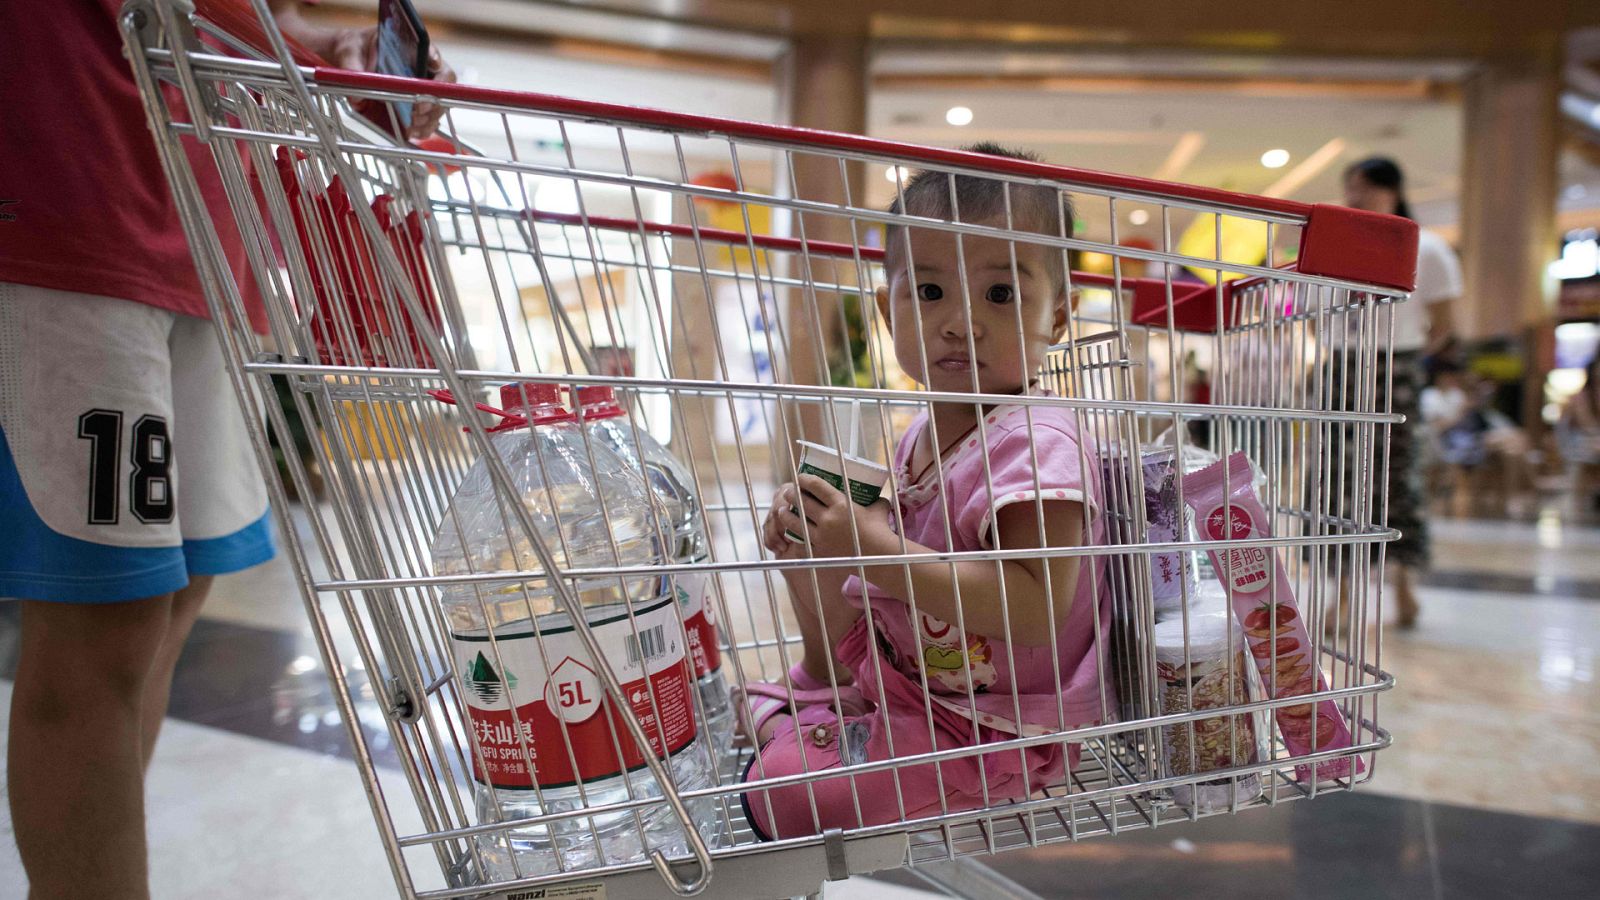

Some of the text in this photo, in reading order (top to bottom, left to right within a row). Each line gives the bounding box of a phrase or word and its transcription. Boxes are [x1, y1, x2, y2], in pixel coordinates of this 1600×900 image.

[78, 408, 174, 525] 18
[558, 680, 592, 708] 5L
[499, 746, 537, 760] SPRIG
